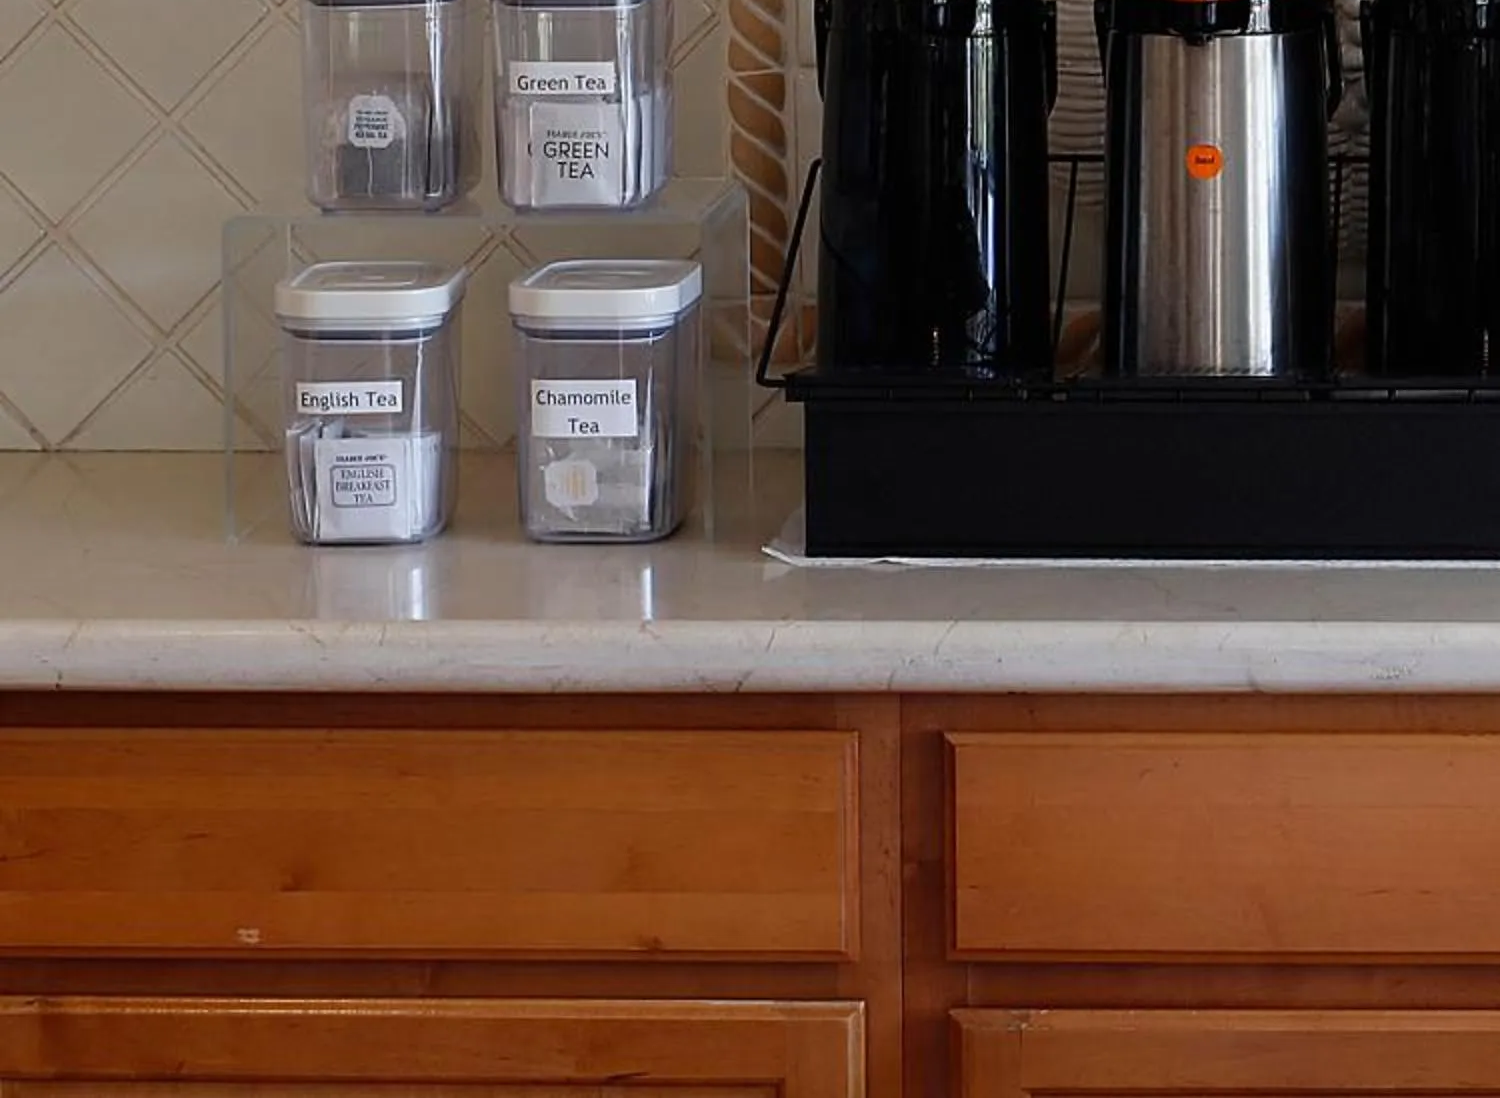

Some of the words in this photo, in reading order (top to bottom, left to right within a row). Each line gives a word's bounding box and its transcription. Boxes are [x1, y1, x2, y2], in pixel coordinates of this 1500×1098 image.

[517, 74, 569, 91] Green
[574, 74, 607, 91] Tea
[543, 141, 610, 159] GREEN
[557, 161, 595, 180] TEA
[300, 390, 360, 411] English
[365, 391, 398, 407] Tea
[535, 388, 632, 406] Chamomile
[567, 417, 600, 434] Tea
[341, 468, 385, 480] ENGLISH
[352, 492, 374, 504] TEA
